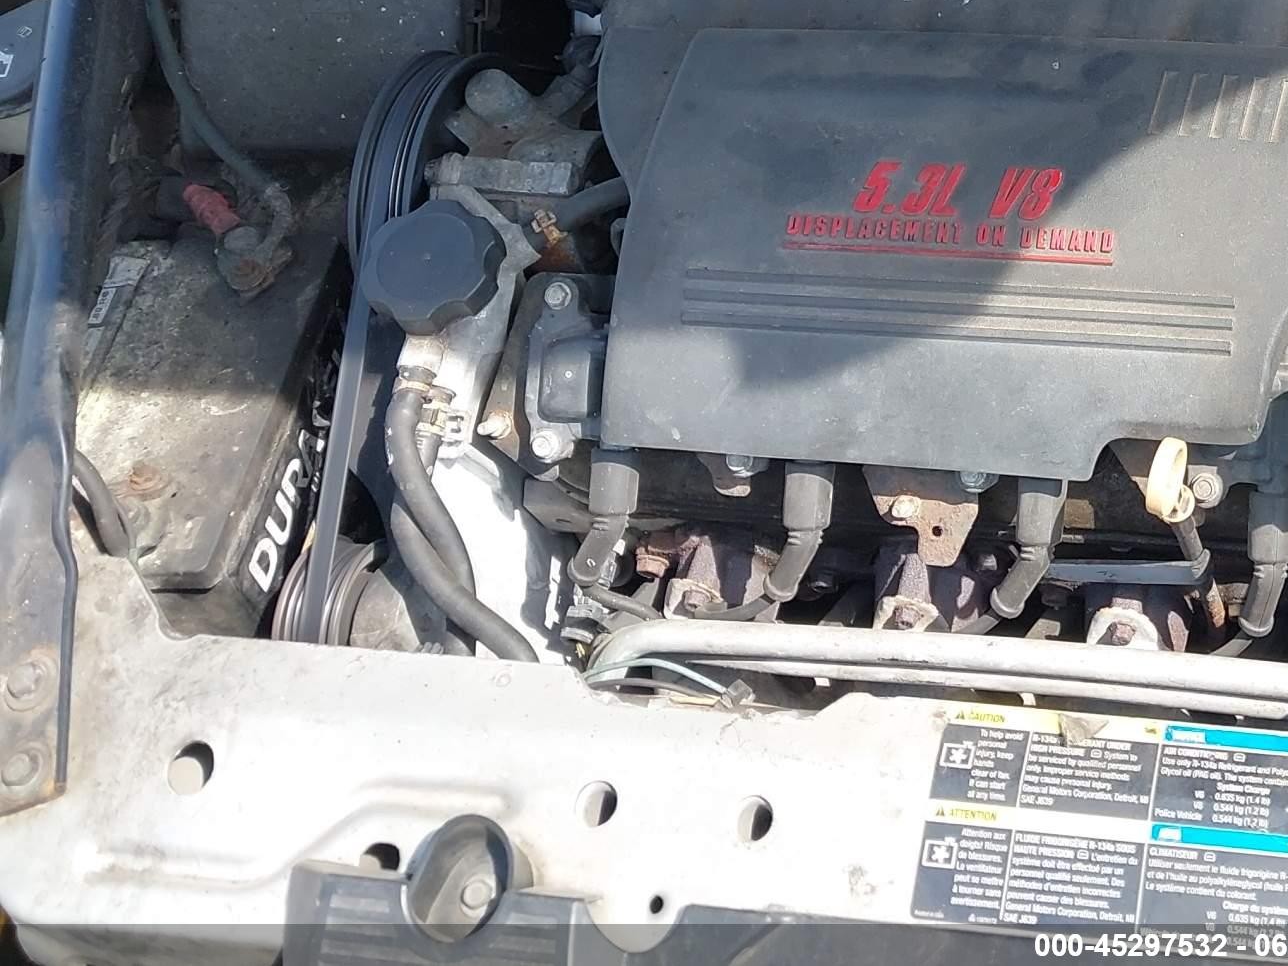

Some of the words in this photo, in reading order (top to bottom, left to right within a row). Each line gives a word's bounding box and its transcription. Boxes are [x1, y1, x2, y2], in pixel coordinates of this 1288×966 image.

[854, 159, 966, 217] 5.3L
[990, 165, 1064, 221] V8
[786, 214, 964, 245] DISPLACEMENT
[976, 223, 1006, 247] ON
[1020, 225, 1115, 254] DEMAND
[968, 712, 1005, 722] CAUTION
[989, 730, 1004, 739] help
[1005, 732, 1023, 740] avoid
[978, 740, 1007, 749] personal
[1031, 744, 1047, 752] HIGH
[1049, 746, 1085, 756] PRESSURE
[997, 751, 1014, 760] keep
[1103, 752, 1129, 761] System
[1039, 755, 1067, 764] serviced
[1068, 758, 1076, 766] by
[1077, 759, 1106, 769] qualified
[1107, 762, 1141, 772] personnel
[1176, 759, 1191, 767] only
[1218, 762, 1256, 773] Refrigerant
[1043, 766, 1073, 776] Improper
[1074, 770, 1099, 778] service
[1100, 772, 1130, 780] methods
[1160, 767, 1181, 777] Glycol
[1238, 775, 1263, 784] system
[989, 781, 1005, 789] start
[1216, 782, 1244, 792] System
[1244, 785, 1270, 795] Charge
[976, 791, 988, 800] any
[1021, 795, 1035, 803] SAE
[1022, 784, 1048, 793] General
[1049, 787, 1072, 796] Motors
[1073, 789, 1114, 801] Corporation,
[1114, 793, 1139, 803] Detroit,
[1236, 794, 1245, 803] kg
[1213, 803, 1234, 812] 0.544
[1234, 805, 1244, 814] kg
[950, 809, 996, 820] ATTENTION
[1154, 808, 1175, 817] Police
[1176, 810, 1202, 820] Vehicle
[1212, 814, 1232, 823] 0.544
[1233, 816, 1243, 825] kg
[961, 828, 992, 838] Attention
[1014, 844, 1038, 854] HAUTE
[1039, 847, 1075, 858] PRESSION
[1116, 843, 1136, 853] SOUS
[1149, 847, 1198, 859] CLIMATISEUR
[1041, 859, 1056, 868] doit
[1128, 856, 1138, 865] du
[966, 863, 1002, 873] ventilateur
[1148, 858, 1172, 867] Utiliser
[1174, 862, 1210, 871] seulement
[1220, 866, 1239, 875] fluide
[954, 874, 969, 882] peut
[1010, 868, 1044, 878] personnel
[1111, 878, 1125, 886] Des
[1186, 886, 1215, 895] contient
[1035, 894, 1059, 903] causer
[1060, 896, 1073, 904] des
[1005, 902, 1031, 911] General
[1032, 904, 1056, 914] Motors
[1056, 907, 1099, 919] Corporation,
[1099, 911, 1125, 922] Detroit,
[1222, 901, 1249, 912] Charge
[1003, 913, 1018, 922] SAE
[1206, 911, 1216, 919] V6
[1249, 915, 1259, 925] kg
